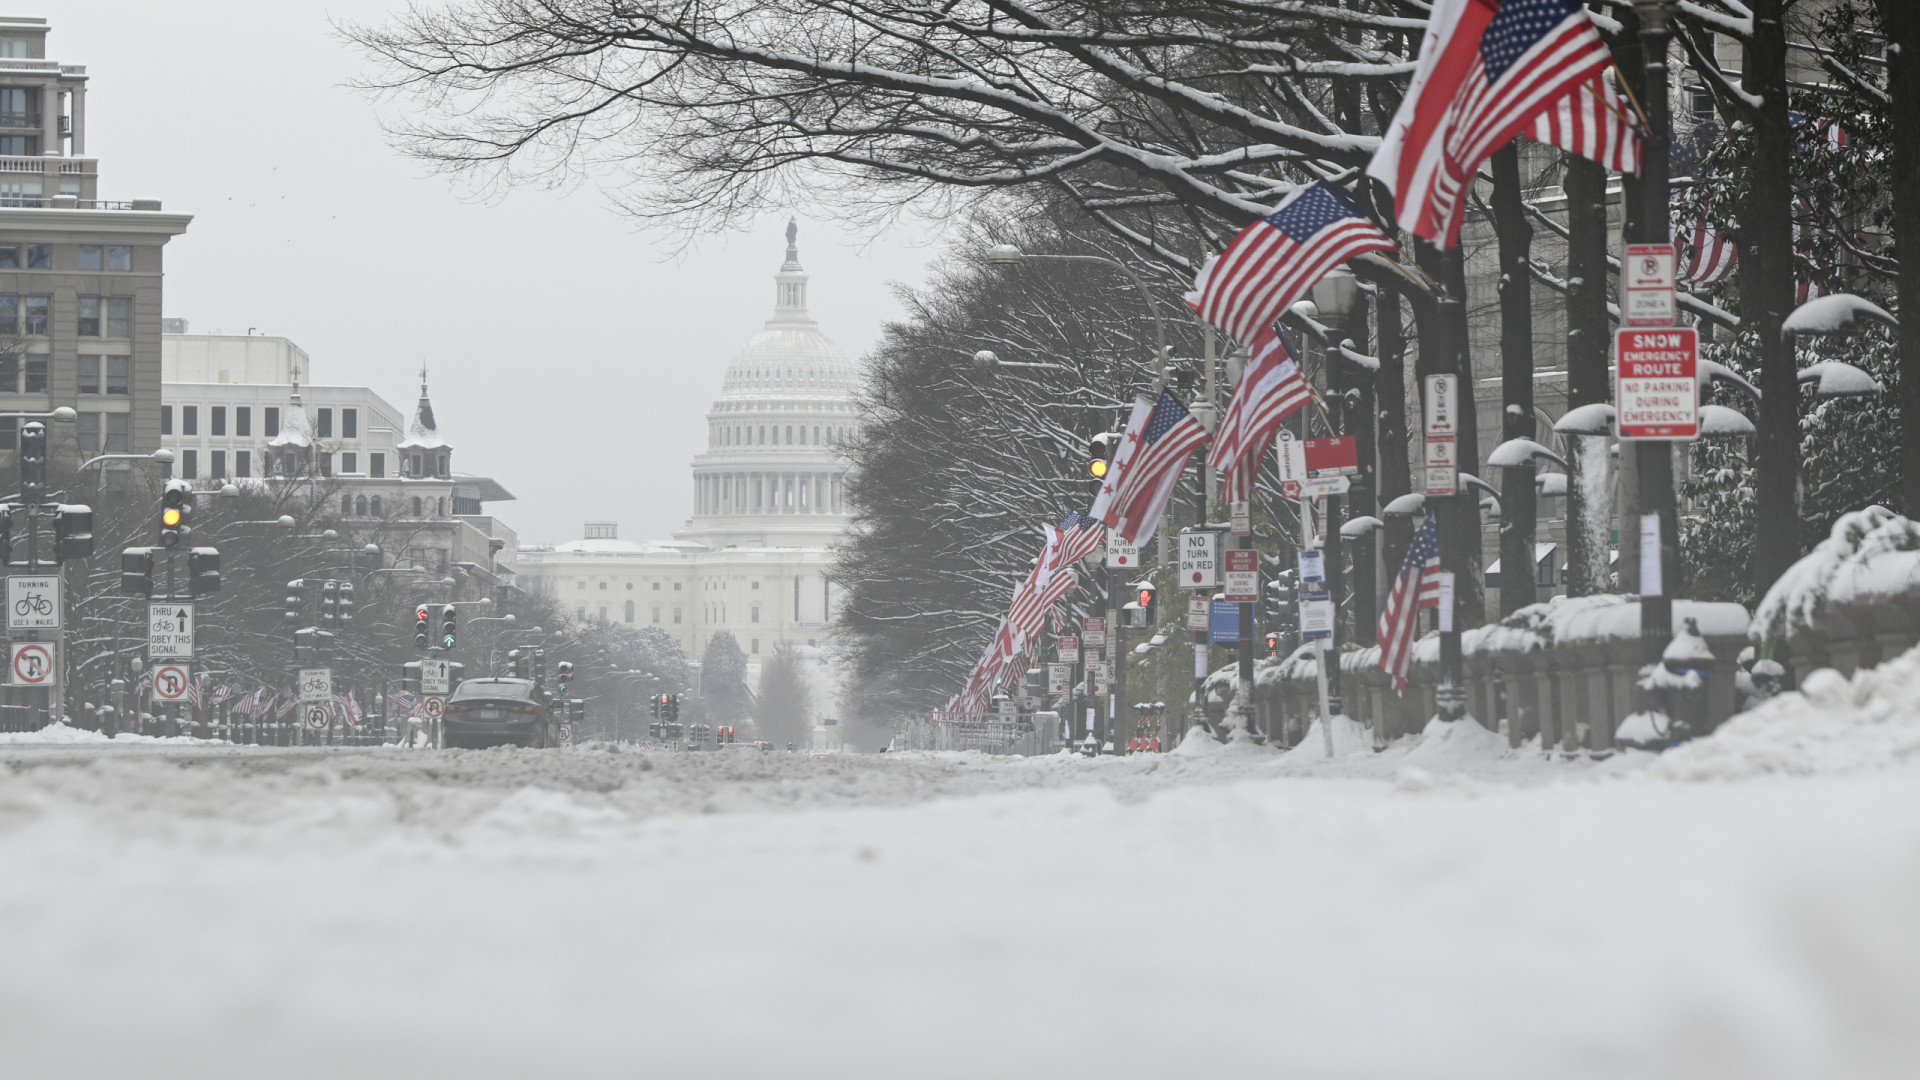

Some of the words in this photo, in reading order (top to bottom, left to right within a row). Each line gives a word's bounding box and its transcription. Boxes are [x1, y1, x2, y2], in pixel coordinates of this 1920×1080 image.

[1633, 334, 1682, 348] SNOW
[1623, 351, 1690, 362] EMERGENCY
[1633, 363, 1682, 375] ROUTE
[1624, 382, 1639, 392] NO
[1644, 382, 1690, 392] PARKING
[1636, 396, 1680, 407] DURING
[1624, 411, 1691, 421] EMERGENCY
[1283, 443, 1291, 479] metrobus
[1189, 536, 1205, 547] NO
[1187, 549, 1208, 558] TURN
[1182, 561, 1193, 570] ON
[1197, 560, 1213, 569] RED
[152, 607, 172, 616] THRU
[151, 635, 171, 644] OBEY
[175, 635, 191, 644] THIS
[151, 645, 178, 654] SIGNAL
